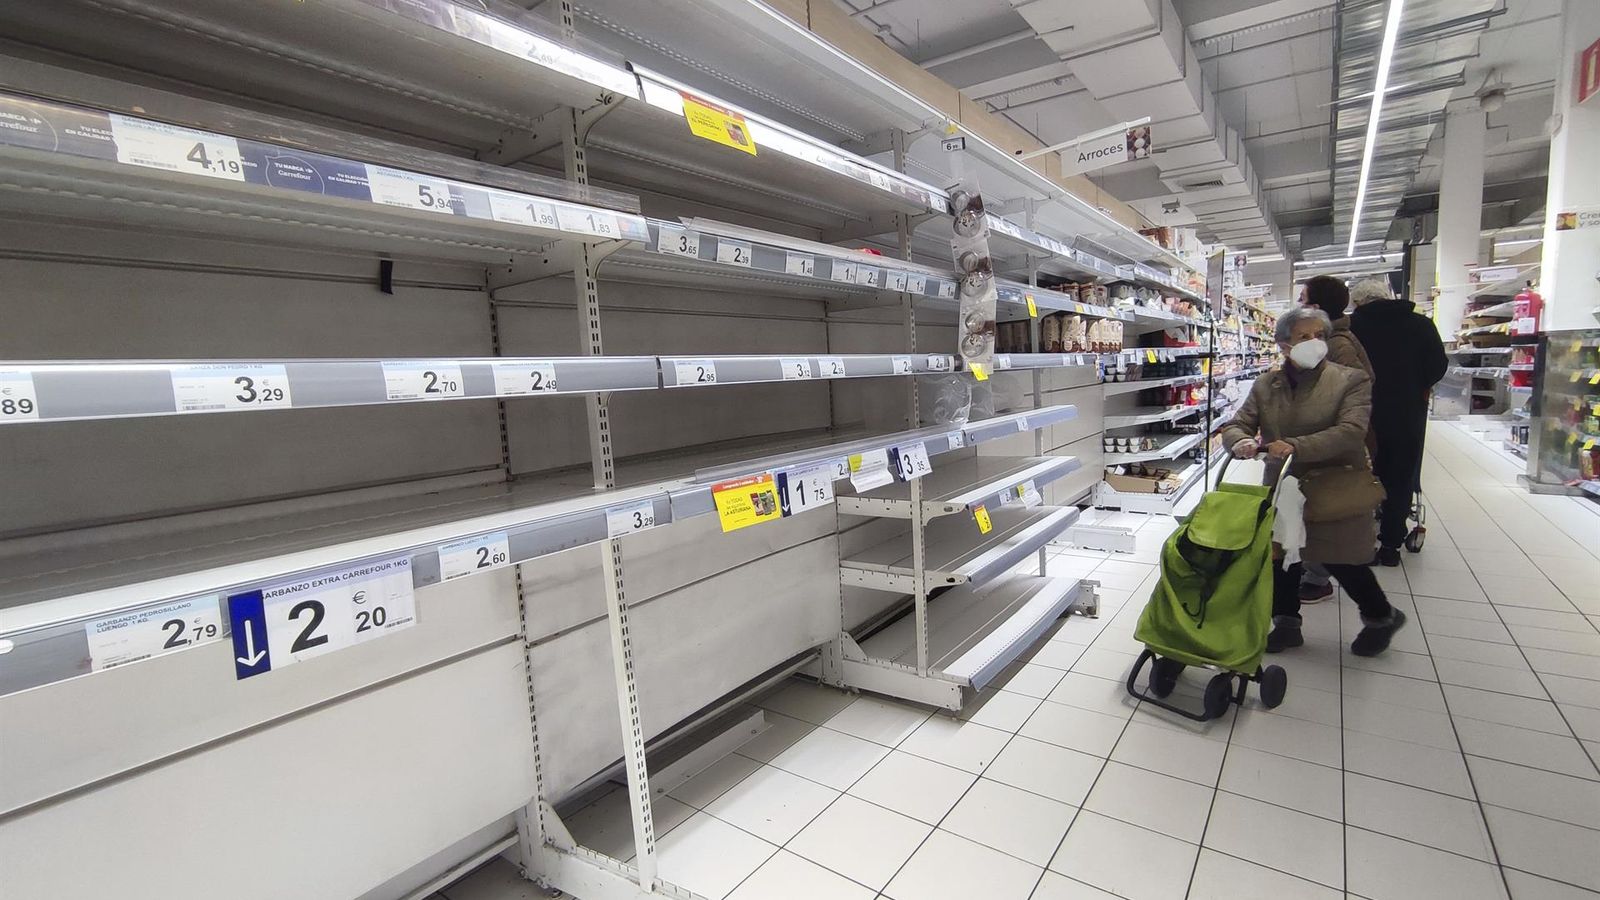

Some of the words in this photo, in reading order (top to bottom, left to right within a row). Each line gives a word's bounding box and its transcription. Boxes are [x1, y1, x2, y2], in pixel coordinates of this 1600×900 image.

[187, 142, 240, 174] 4,19
[1078, 143, 1124, 163] Arroces
[278, 169, 311, 180] Carrefour
[283, 164, 304, 172] MARCA
[419, 184, 453, 210] 5,94
[526, 203, 554, 225] 1,99
[679, 236, 697, 254] 3,65
[423, 371, 457, 395] 2,70
[531, 371, 557, 392] 2,49
[697, 366, 715, 383] 2,95
[234, 376, 284, 404] 3,29
[904, 454, 914, 475] 3
[796, 480, 806, 506] 1
[814, 488, 825, 501] 75
[633, 511, 654, 528] 3,29
[476, 546, 506, 569] 2,60
[312, 575, 341, 588] EXTRA
[342, 562, 392, 581] CARREFOUR
[393, 558, 409, 569] 1KG
[352, 590, 367, 605] €
[96, 614, 138, 628] GARBANZO
[140, 602, 192, 618] PEDROSILLANO
[355, 606, 387, 633] 20
[97, 622, 129, 634] LUENGO
[161, 618, 218, 650] 2,79
[288, 600, 329, 654] 2
